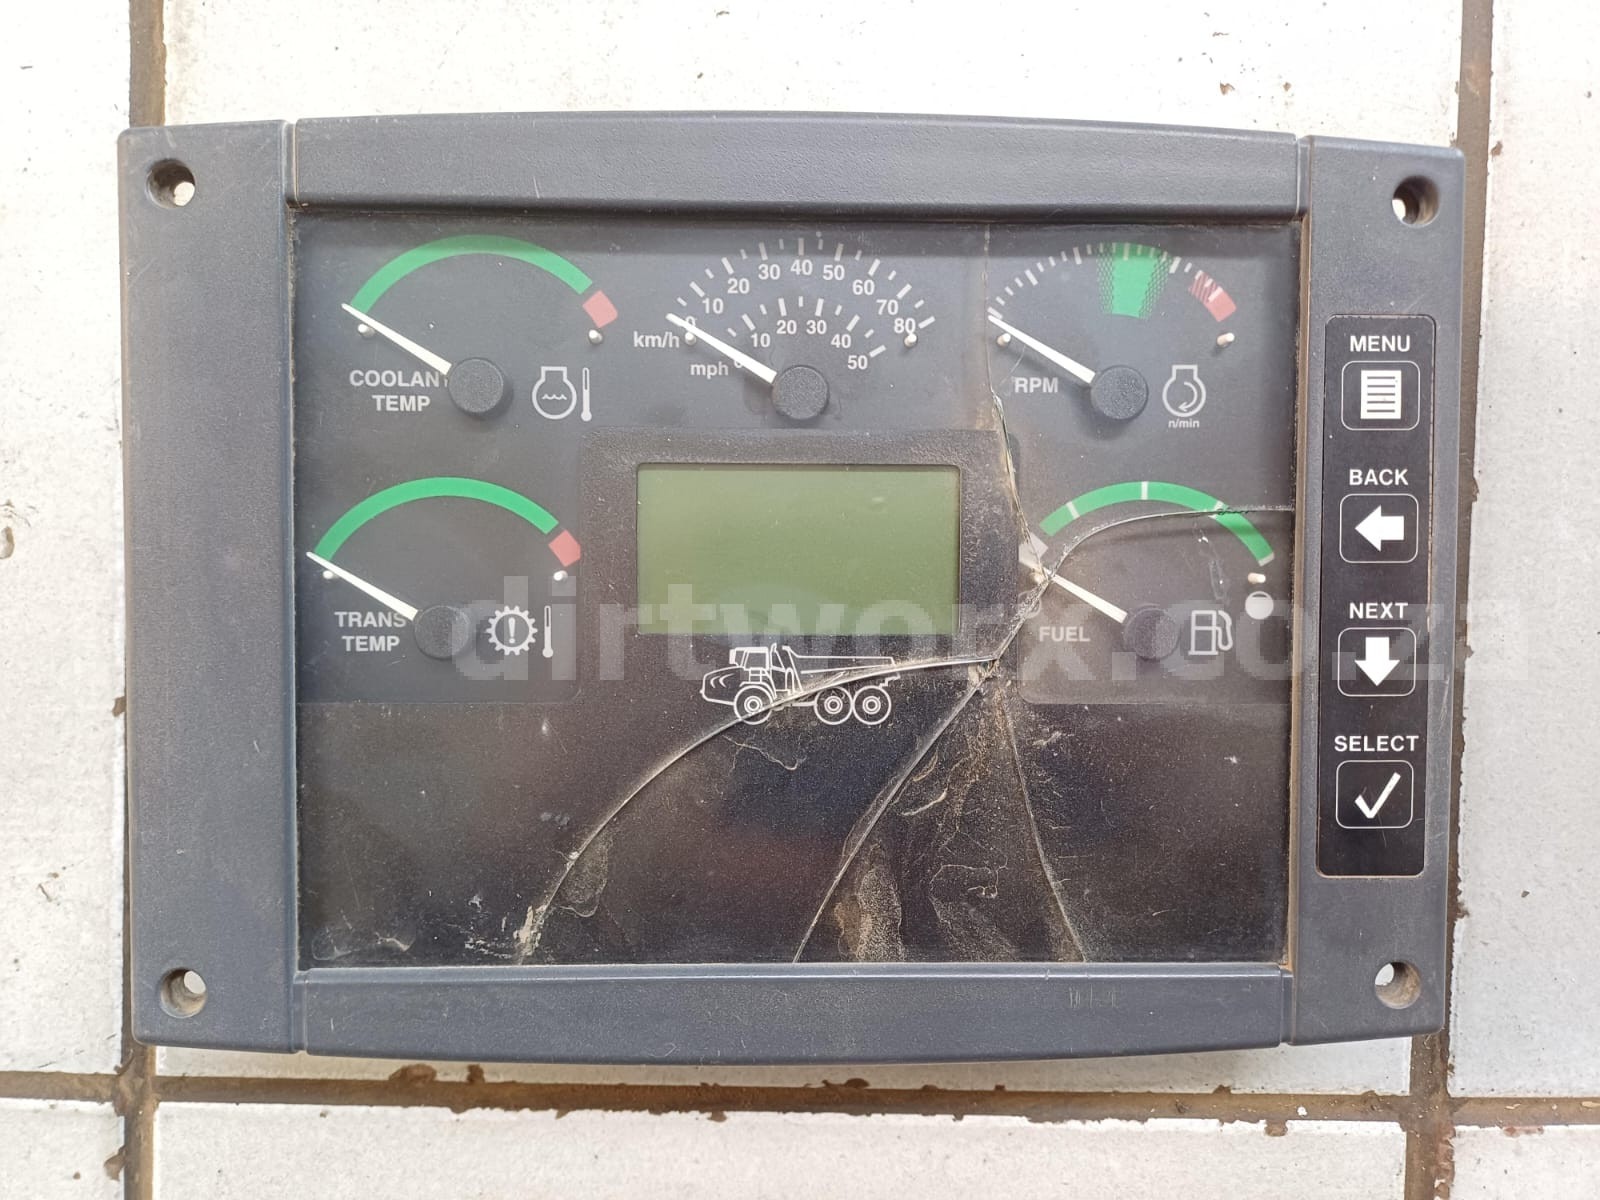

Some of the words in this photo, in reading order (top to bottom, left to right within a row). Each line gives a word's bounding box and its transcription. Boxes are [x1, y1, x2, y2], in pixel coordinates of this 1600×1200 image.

[702, 298, 723, 314] 10
[727, 278, 750, 294] 20
[758, 264, 780, 280] 30
[790, 259, 813, 275] 40
[823, 264, 845, 280] 50
[852, 279, 875, 295] 60
[876, 299, 899, 315] 70
[894, 318, 916, 334] 80
[633, 331, 680, 349] km/h
[750, 333, 771, 347] 10
[776, 319, 797, 334] 20
[806, 319, 827, 334] 30
[831, 333, 852, 348] 40
[847, 355, 868, 370] 50
[1350, 335, 1411, 352] MENU
[690, 361, 729, 379] mph
[1014, 377, 1059, 394] RPM
[372, 395, 431, 412] TEMP
[1168, 418, 1200, 428] n/min
[1348, 468, 1409, 486] BACK
[1349, 602, 1409, 619] NEXT
[334, 611, 407, 628] TRANS
[1038, 626, 1091, 643] FUEL
[342, 635, 400, 652] TEMP
[1333, 735, 1419, 752] SELECT
